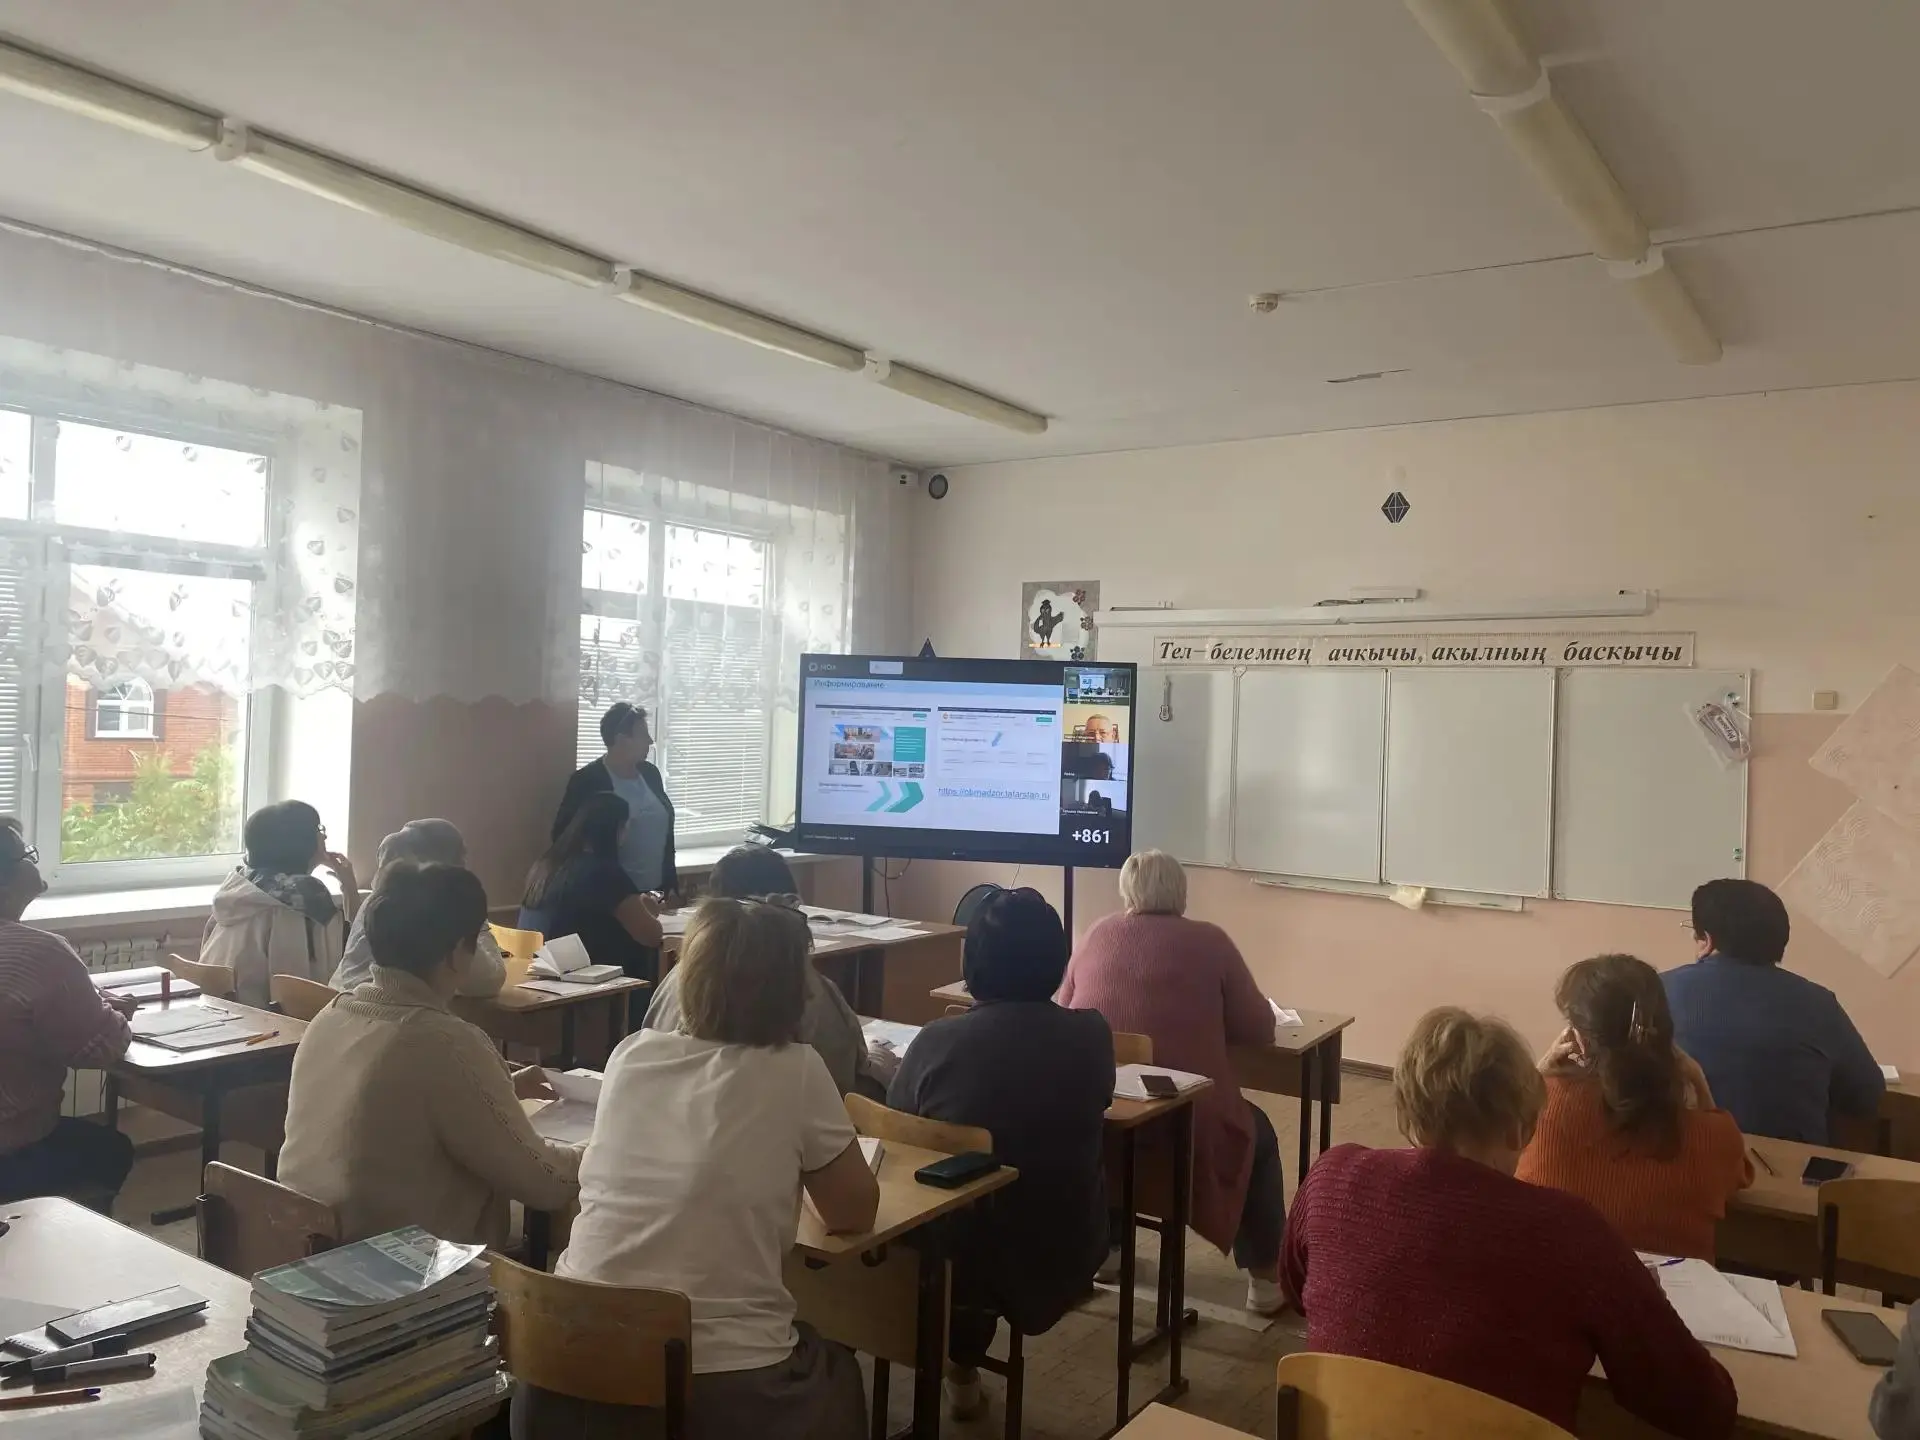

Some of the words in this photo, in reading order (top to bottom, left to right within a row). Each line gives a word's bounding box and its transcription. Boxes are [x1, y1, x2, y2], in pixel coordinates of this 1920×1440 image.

[1210, 643, 1311, 665] белемнең
[1328, 646, 1424, 664] ачкычы,
[1431, 645, 1548, 665] акылның
[1563, 641, 1683, 662] баскычы
[1072, 829, 1110, 844] +861
